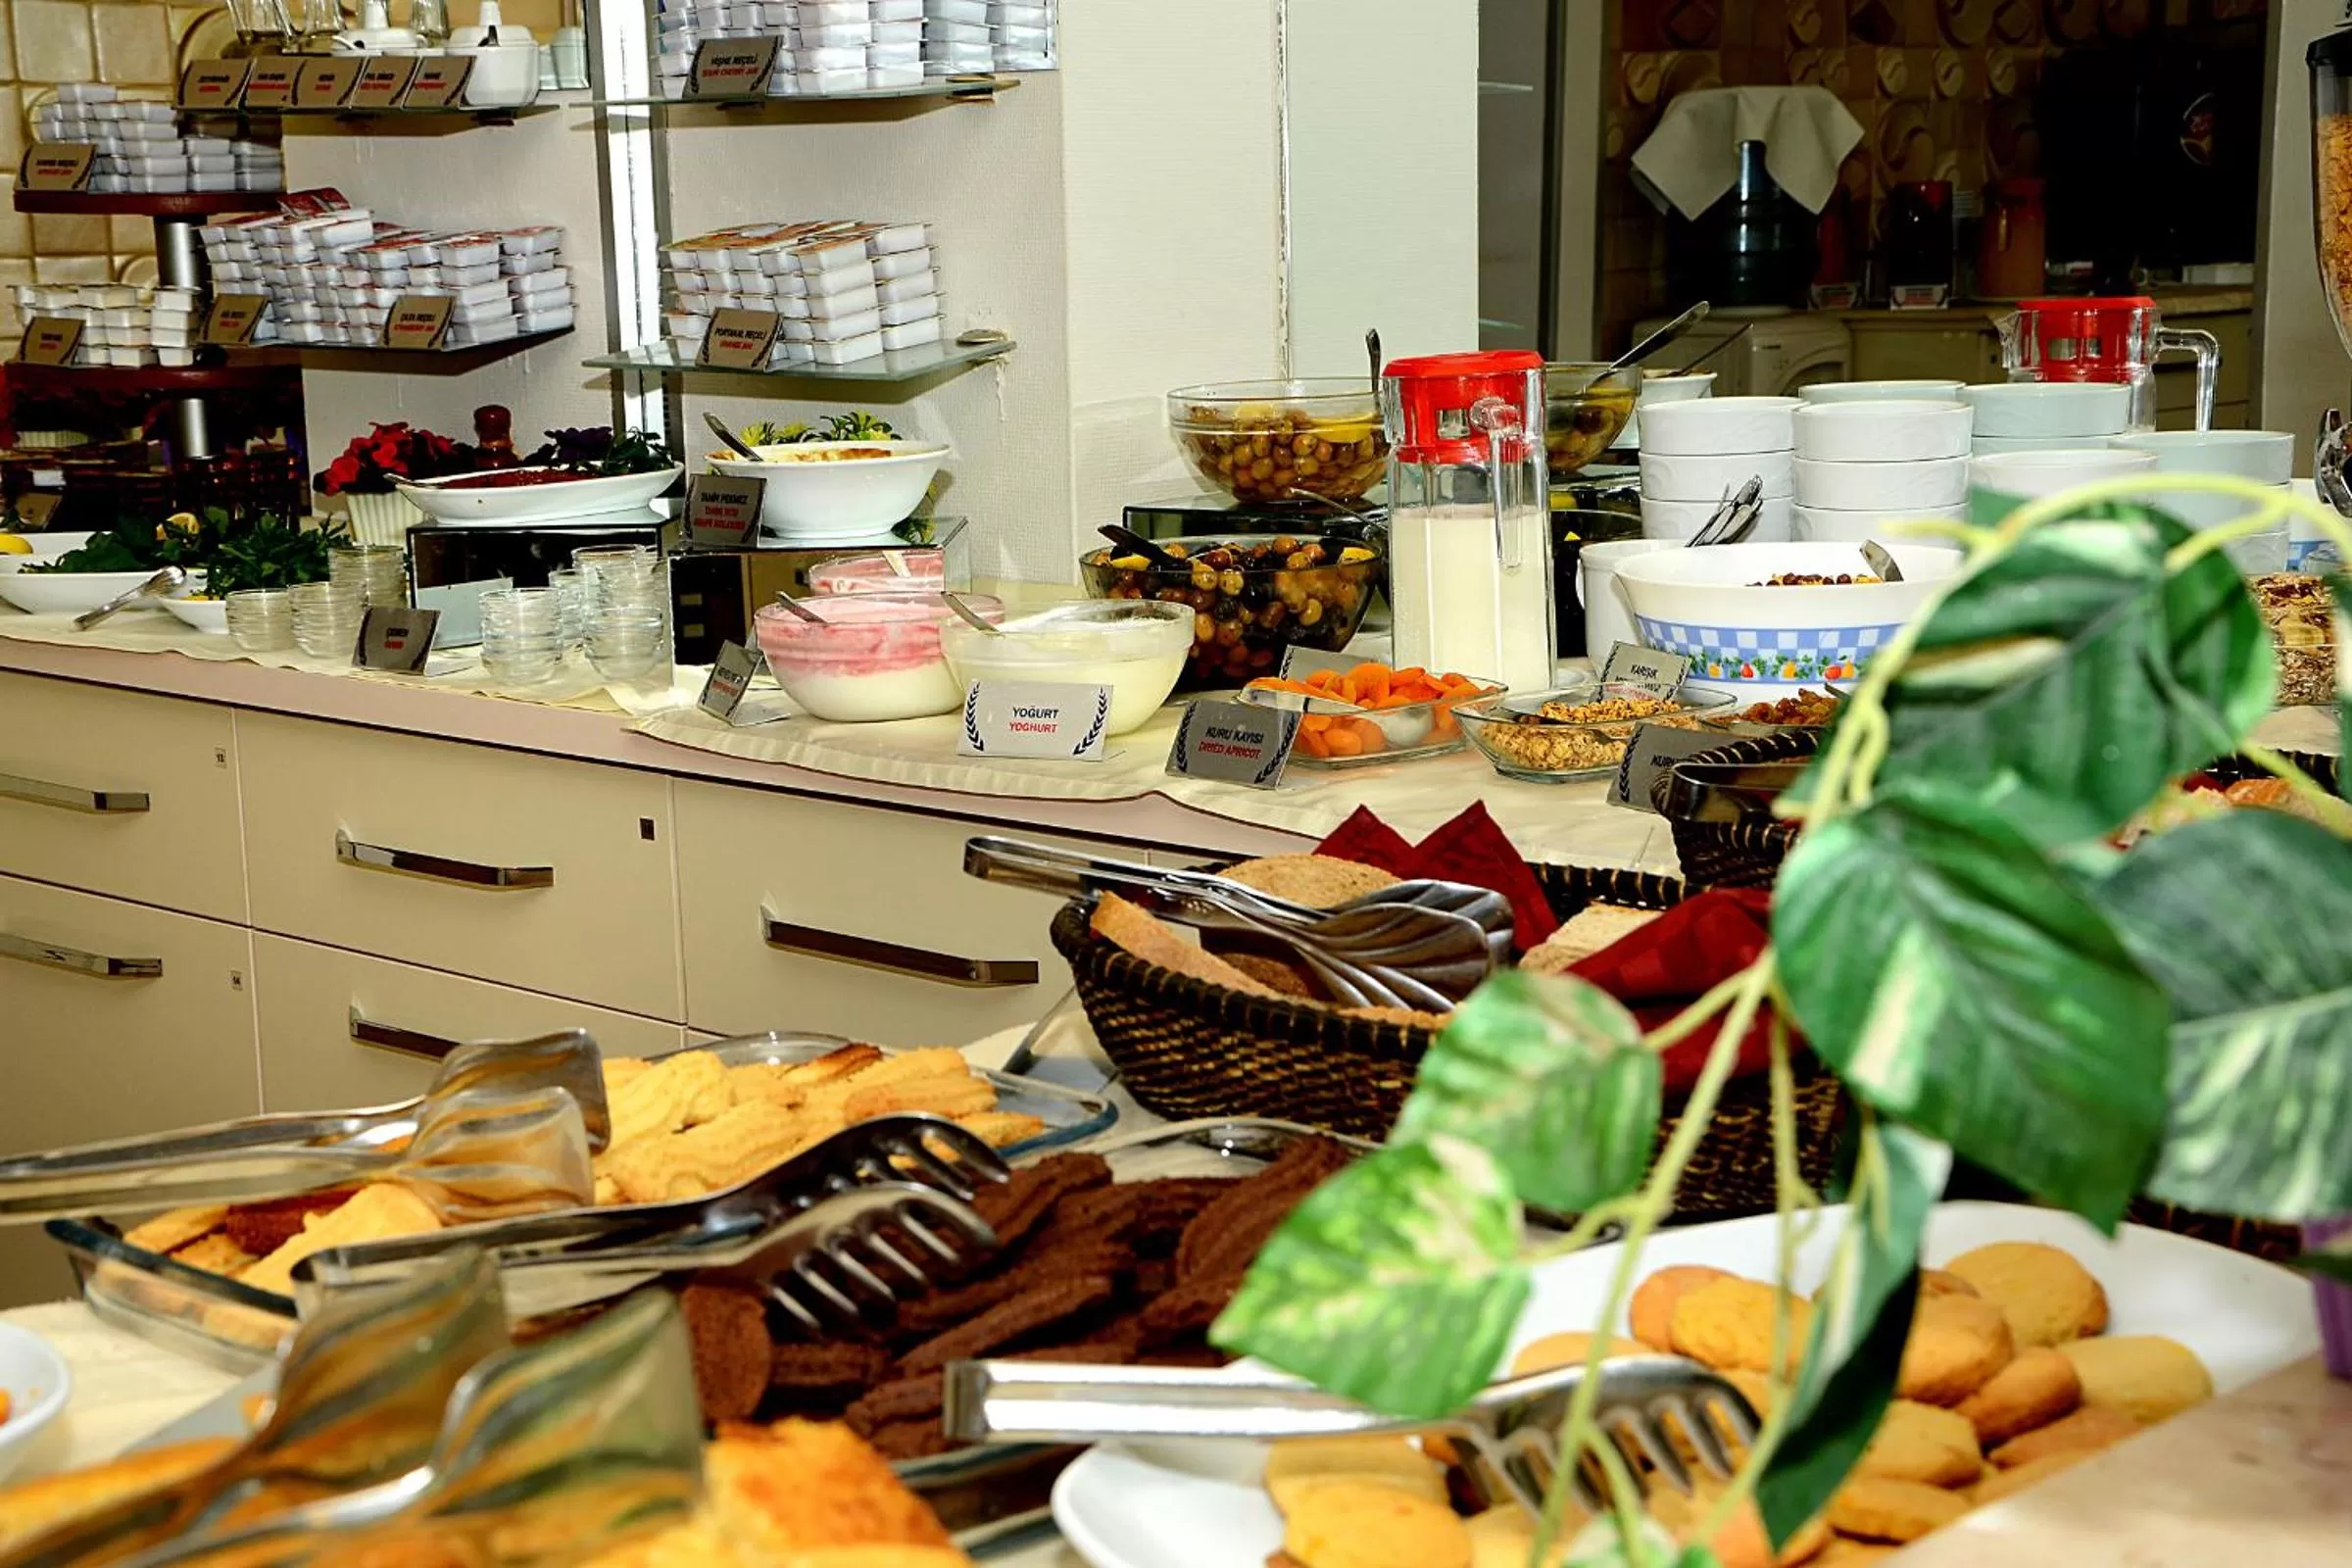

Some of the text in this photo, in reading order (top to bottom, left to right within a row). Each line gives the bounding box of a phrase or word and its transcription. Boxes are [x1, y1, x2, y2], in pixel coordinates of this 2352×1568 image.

[1012, 705, 1059, 719] YOĞURT
[1009, 722, 1058, 733] YOGHURT
[1205, 726, 1264, 744] KURU KAYISI
[1198, 741, 1262, 760] DRIED APRICOT
